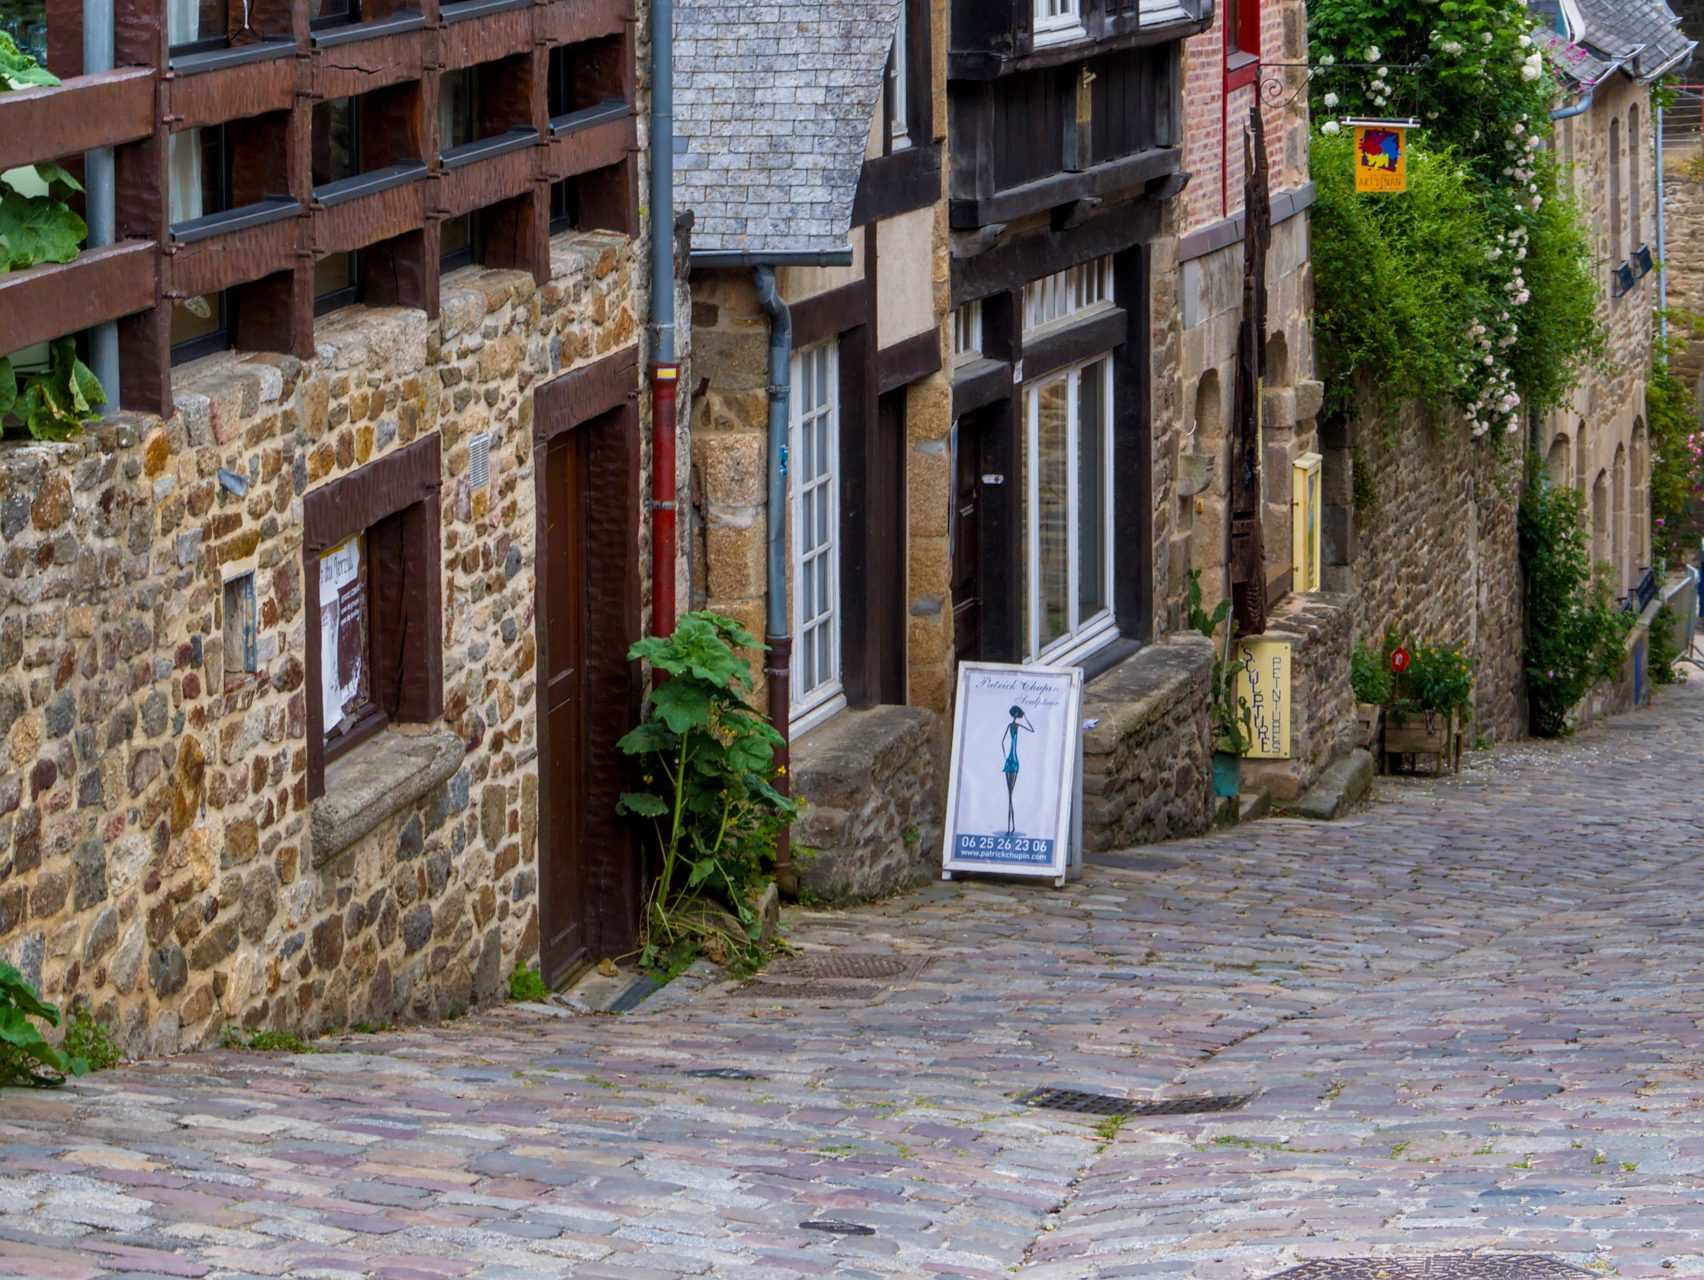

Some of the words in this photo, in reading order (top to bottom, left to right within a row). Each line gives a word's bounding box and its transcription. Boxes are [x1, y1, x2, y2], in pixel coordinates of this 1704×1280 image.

[976, 676, 1017, 690] Patrick
[1020, 678, 1060, 695] Chupin
[1242, 647, 1271, 753] SCULPTURE
[1272, 657, 1282, 753] PEINTURES
[962, 836, 976, 848] 06
[979, 837, 994, 849] 25
[997, 838, 1012, 850] 26
[1015, 839, 1029, 851] 23
[1032, 841, 1047, 852] 06
[961, 850, 1047, 861] www.patrickchupin.com
